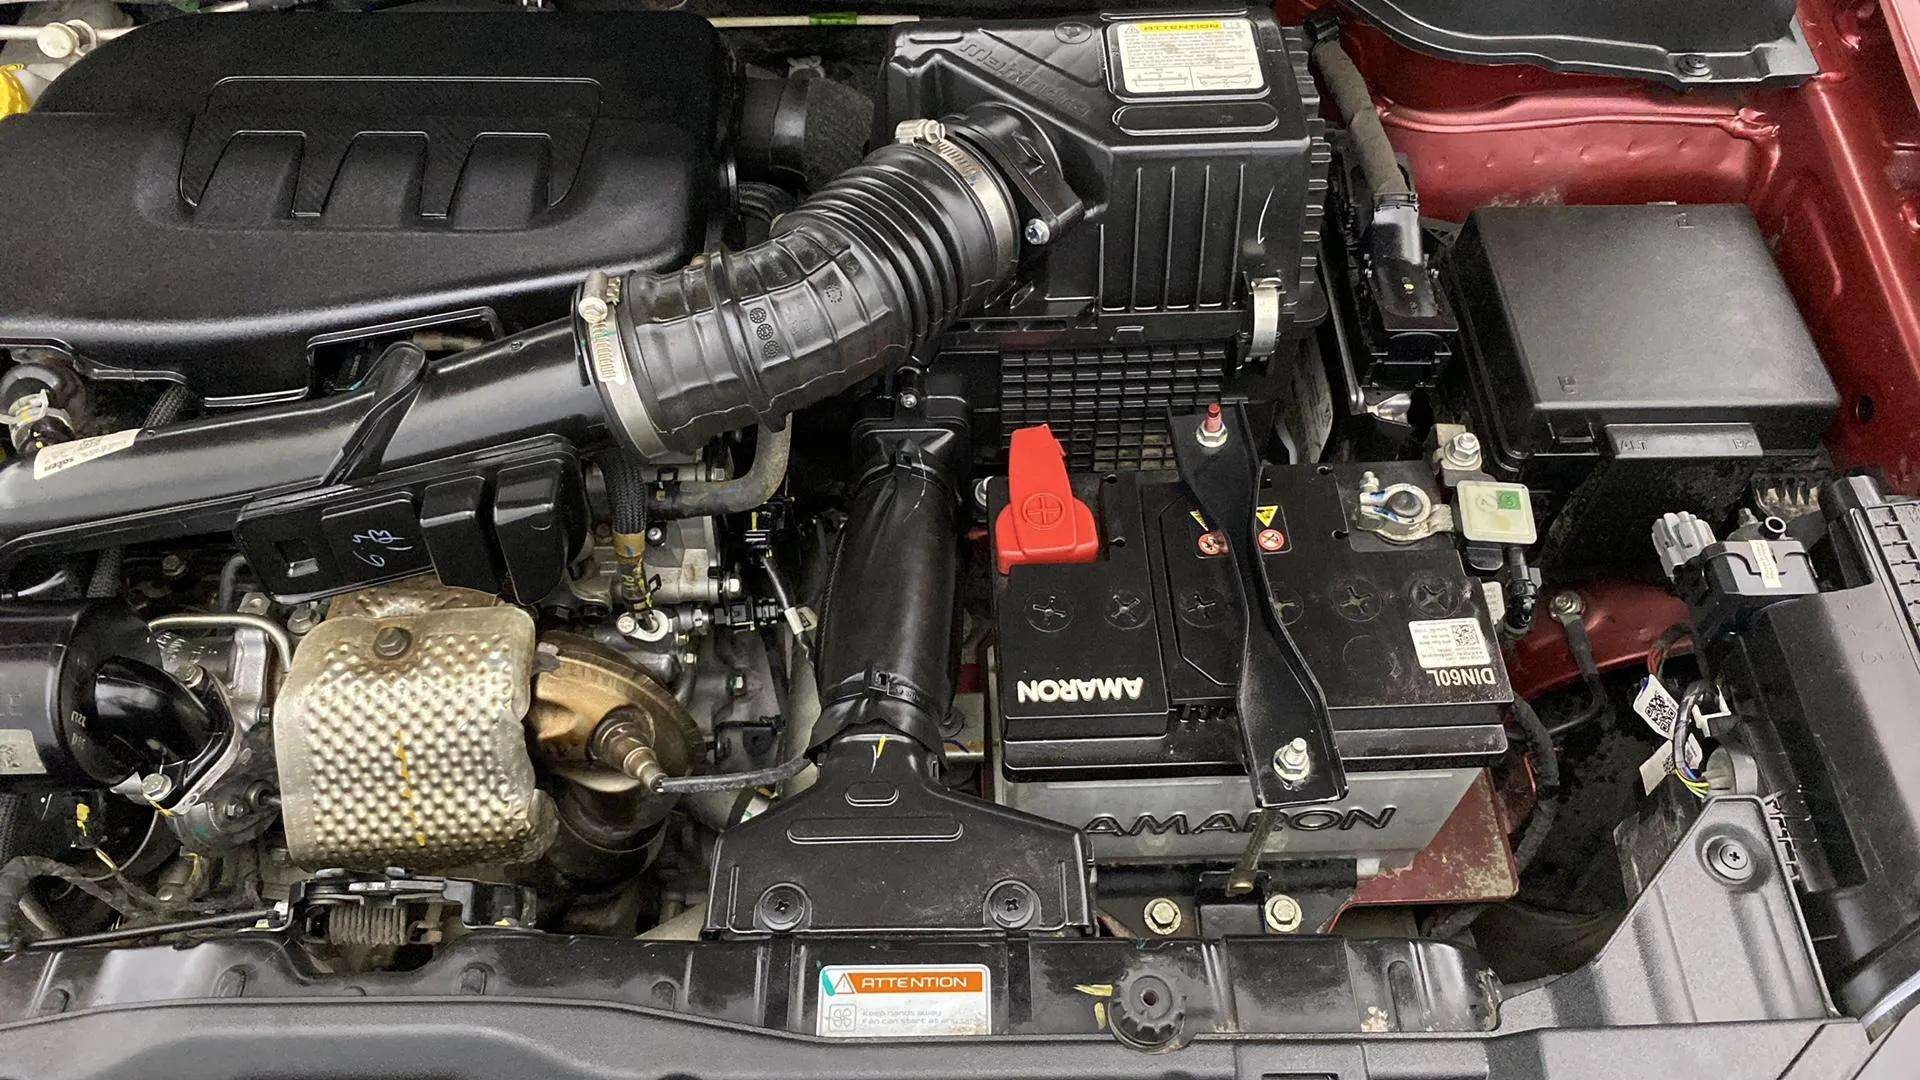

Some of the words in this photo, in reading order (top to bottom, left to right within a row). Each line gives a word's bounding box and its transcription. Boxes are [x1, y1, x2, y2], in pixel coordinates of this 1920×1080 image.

[1143, 22, 1220, 31] ATTENTION
[1426, 668, 1497, 686] DIN60L
[1017, 677, 1144, 703] AMARON
[1085, 805, 1397, 837] AMARON
[861, 976, 968, 989] ATTENTION
